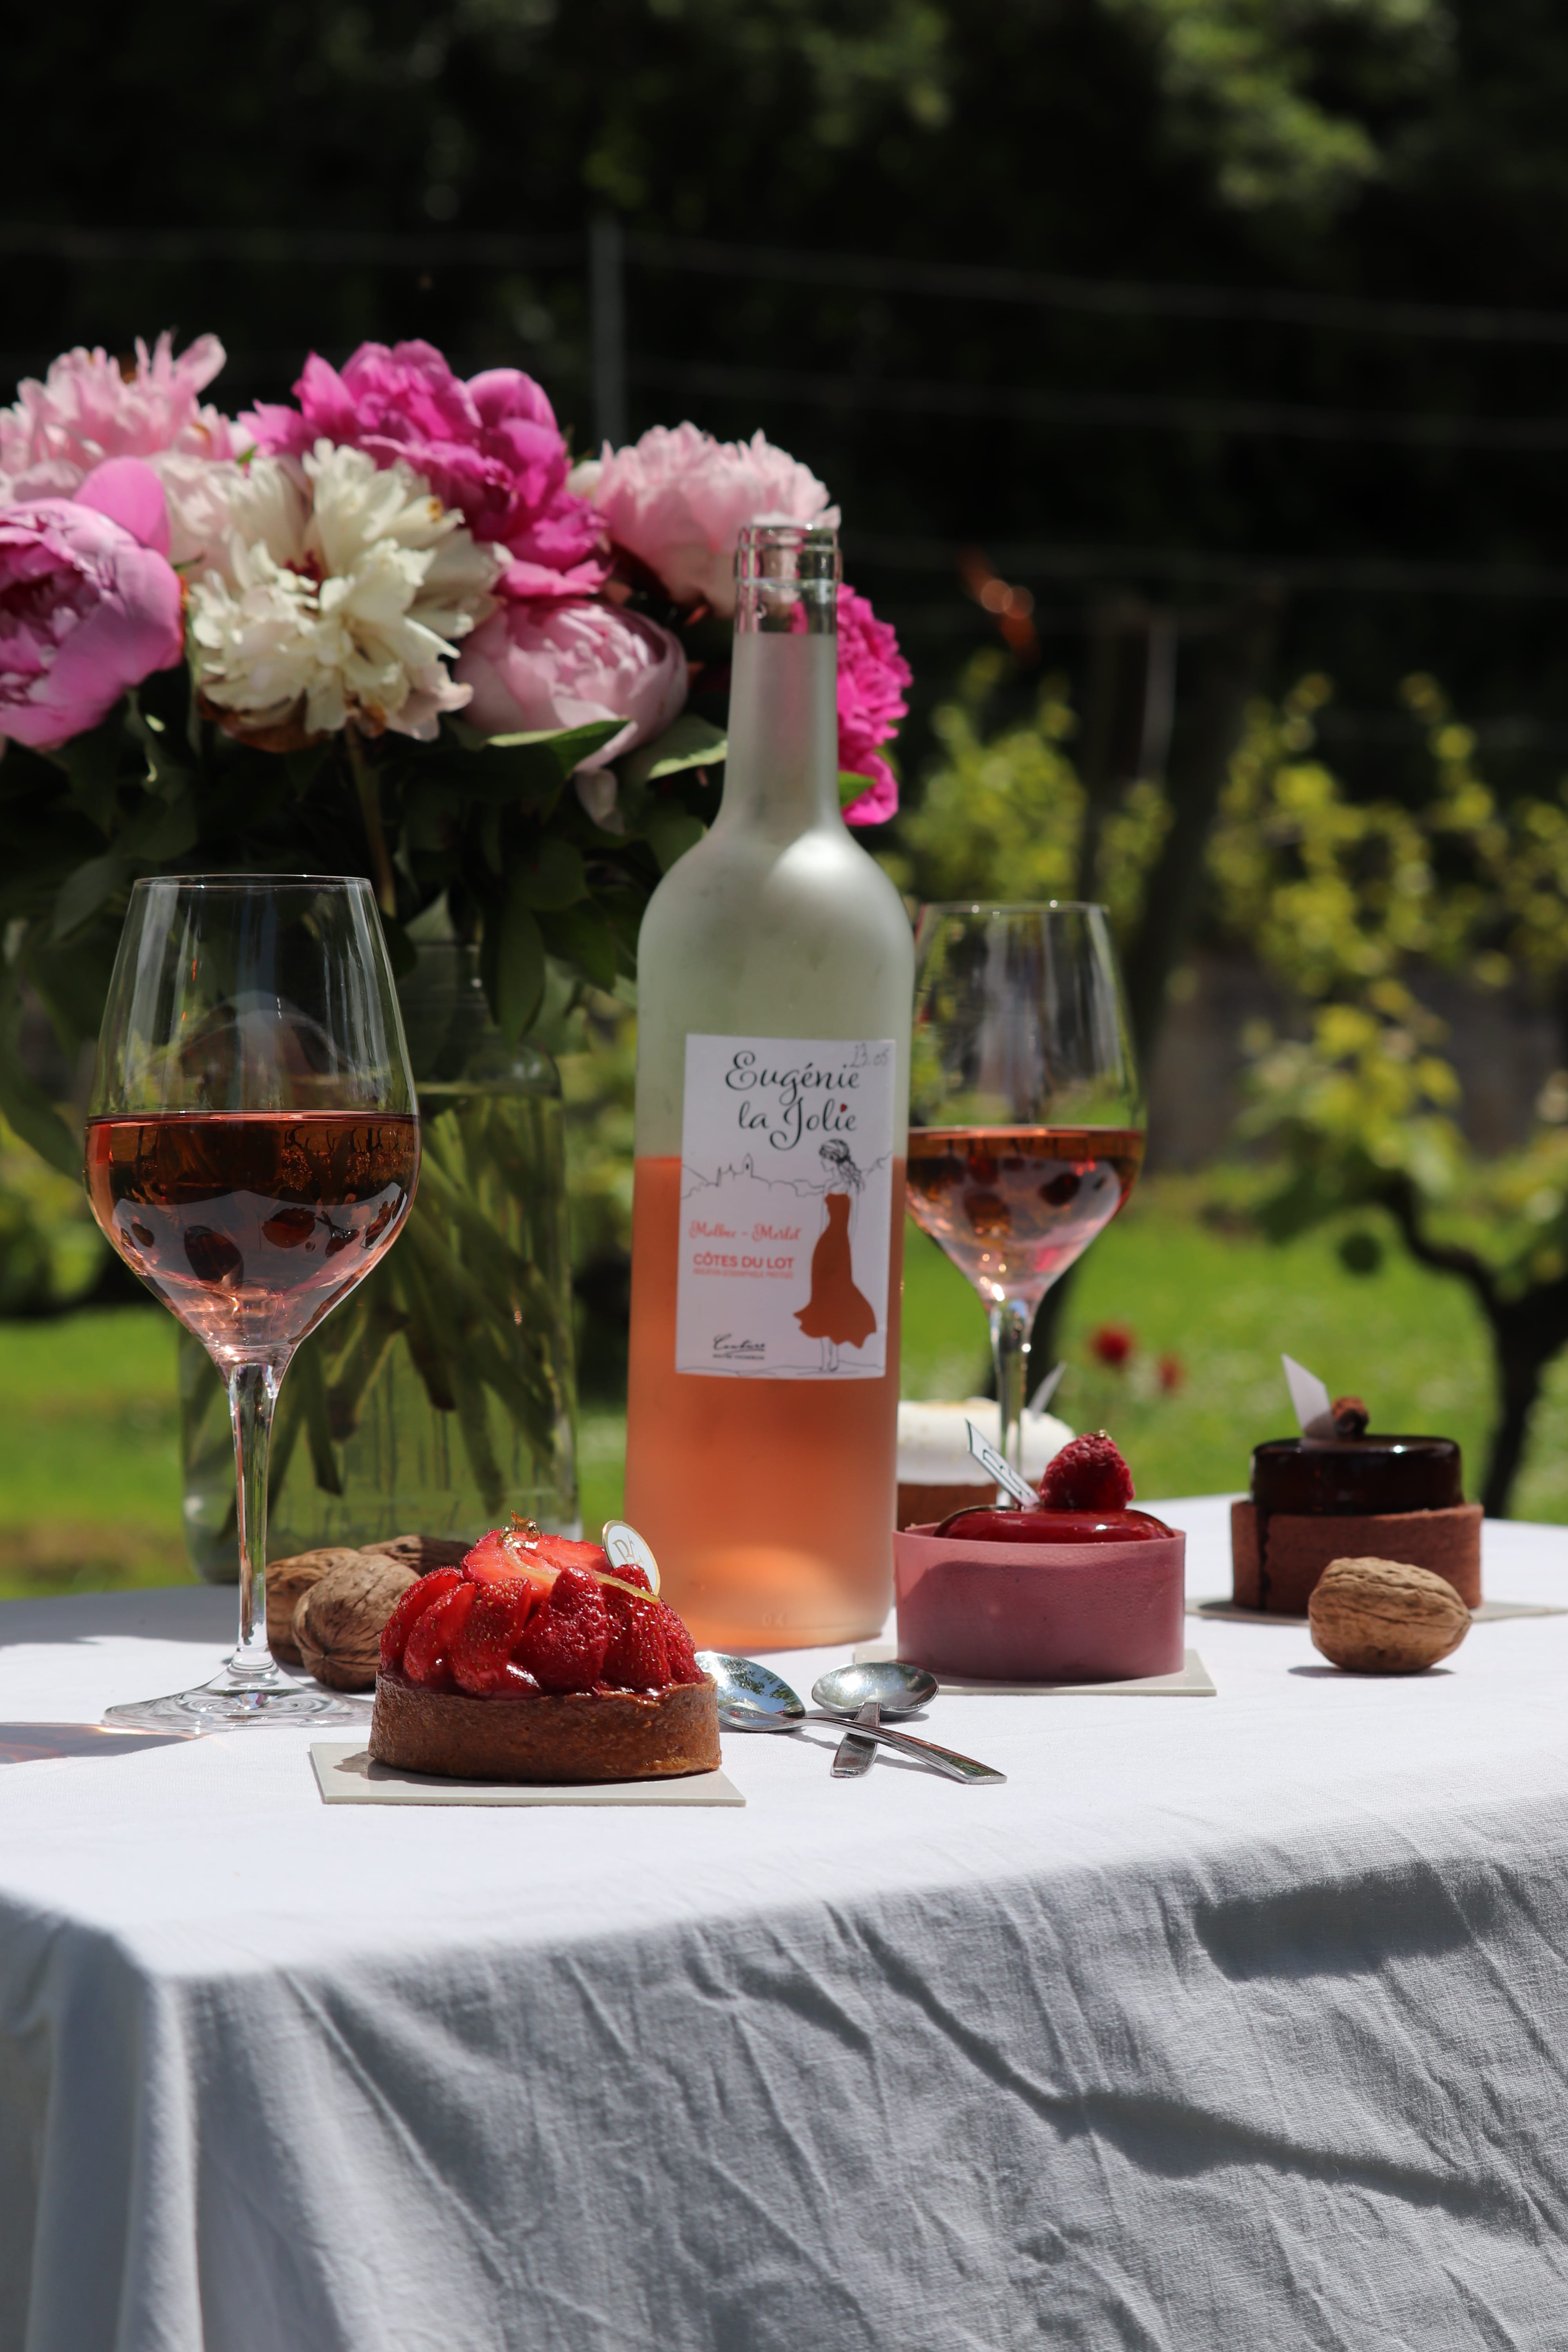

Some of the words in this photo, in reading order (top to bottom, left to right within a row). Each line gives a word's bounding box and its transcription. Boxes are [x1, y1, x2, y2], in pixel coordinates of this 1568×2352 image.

[725, 1050, 860, 1106] Eugénie
[739, 1100, 769, 1129] la
[769, 1096, 857, 1151] Jolie
[693, 1250, 738, 1268] CÔTES
[741, 1255, 764, 1269] DU
[766, 1256, 795, 1270] LOT
